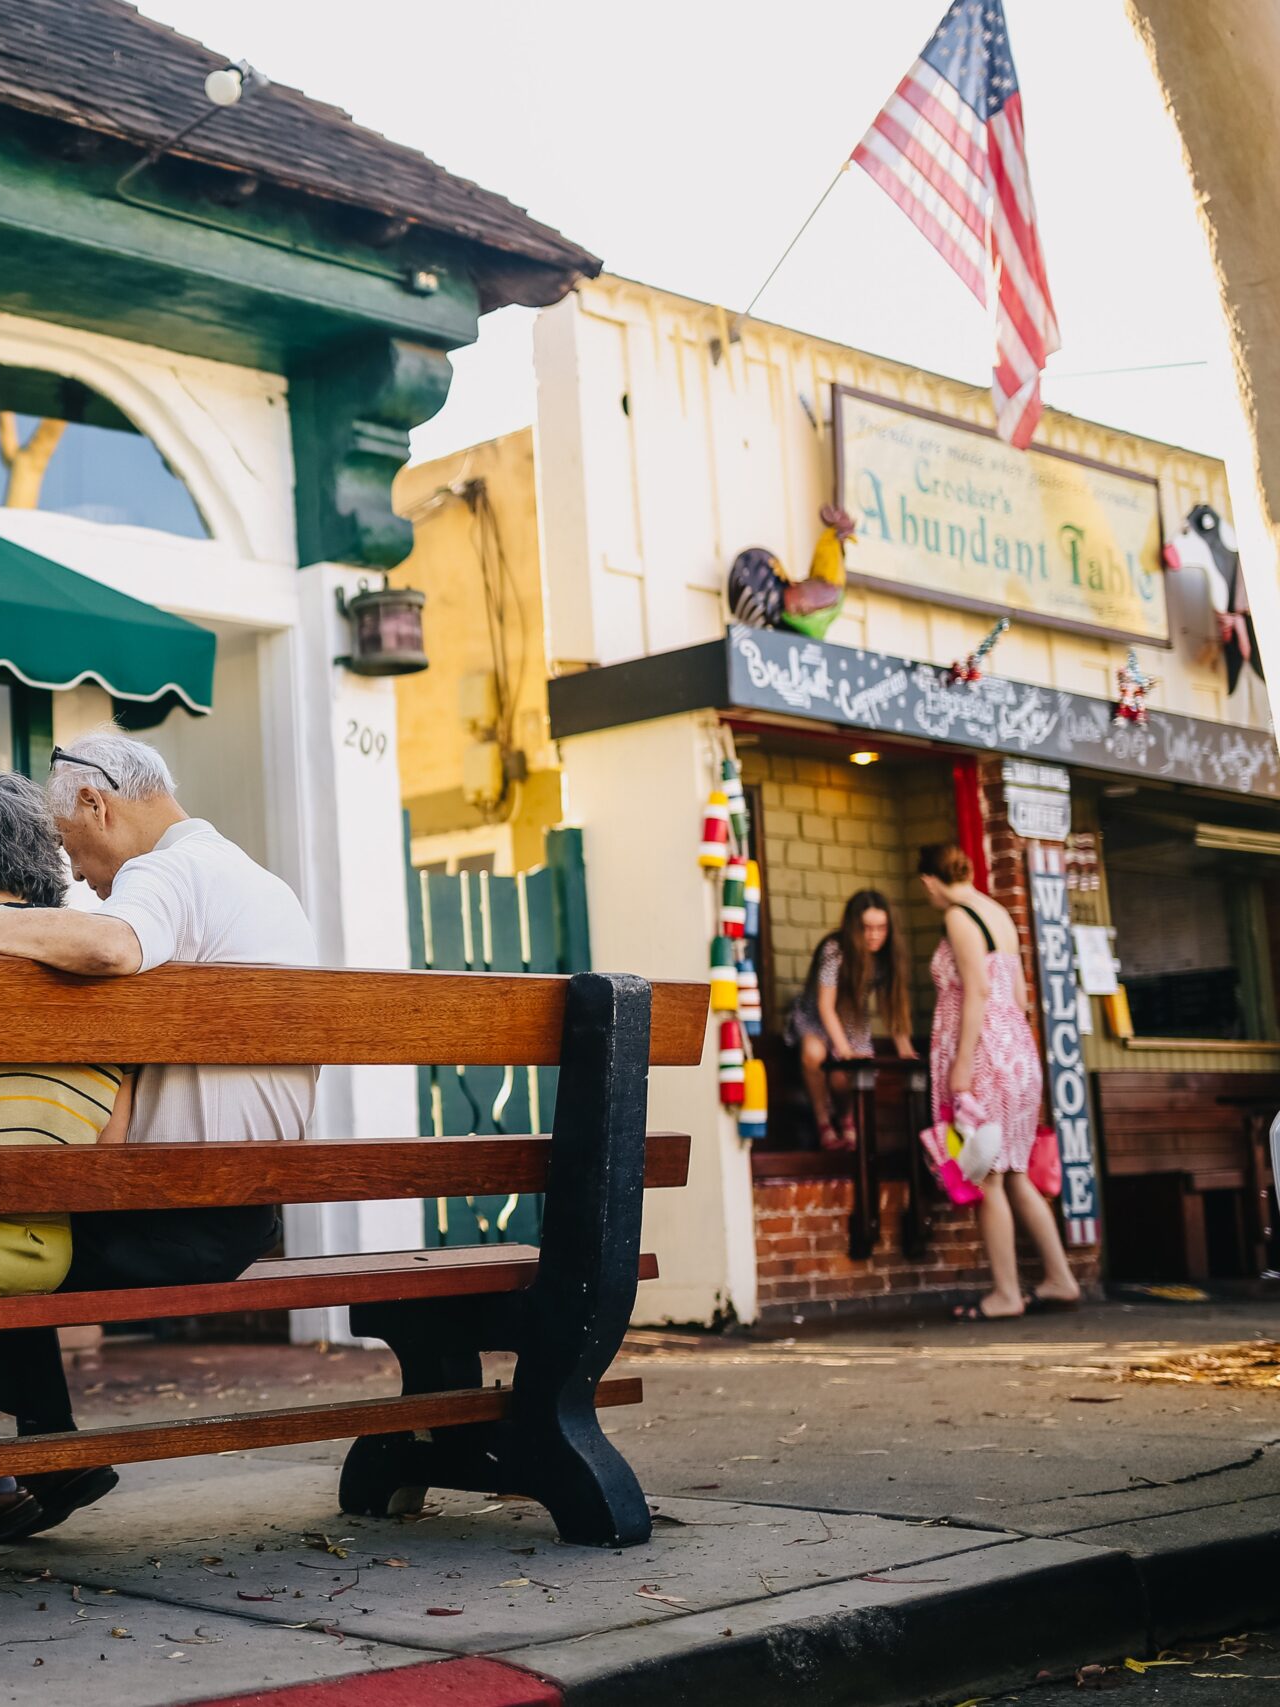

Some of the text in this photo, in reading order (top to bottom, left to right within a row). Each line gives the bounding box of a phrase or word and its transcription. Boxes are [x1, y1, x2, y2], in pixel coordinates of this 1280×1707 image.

[856, 468, 1155, 601] Abundant Table
[343, 718, 387, 763] 209
[1033, 875, 1094, 1217] WELCOME
